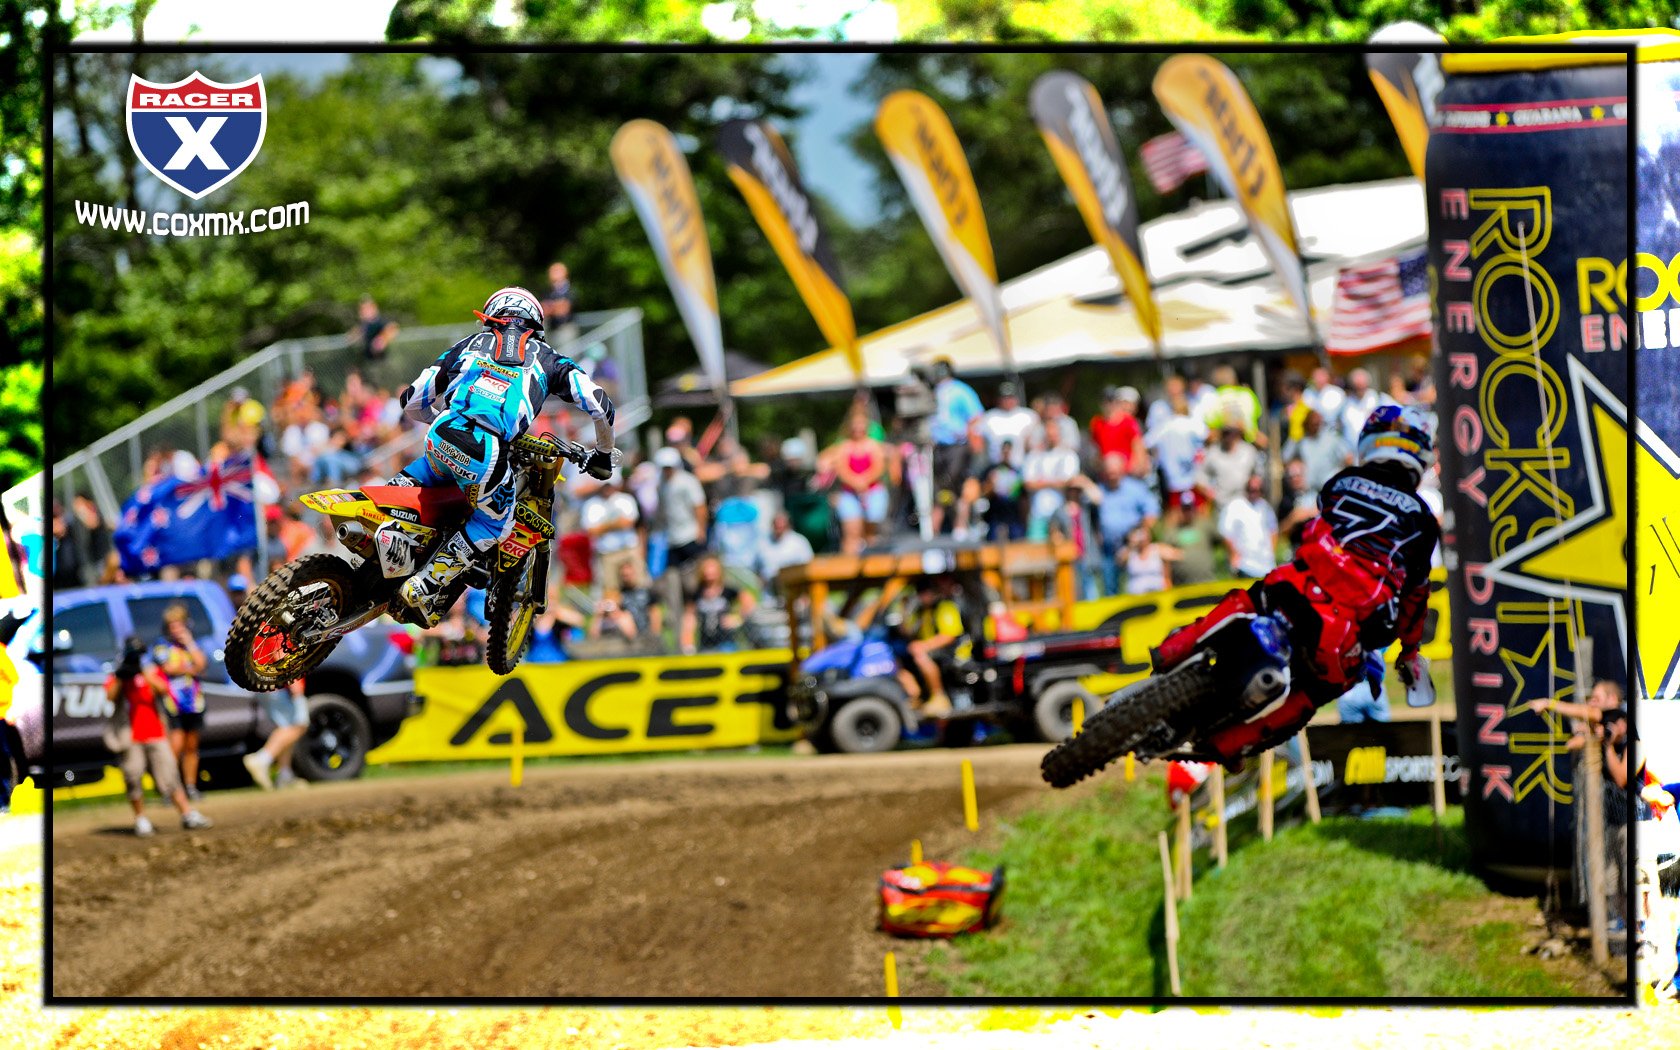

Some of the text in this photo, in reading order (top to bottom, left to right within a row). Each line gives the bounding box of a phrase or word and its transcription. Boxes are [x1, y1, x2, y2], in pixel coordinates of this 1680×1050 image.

[1513, 106, 1582, 127] GUARANA
[433, 448, 478, 481] SUZUKI
[1440, 188, 1514, 802] ENERGY DRINK
[390, 508, 418, 522] SUZUKI
[1332, 494, 1399, 548] 7
